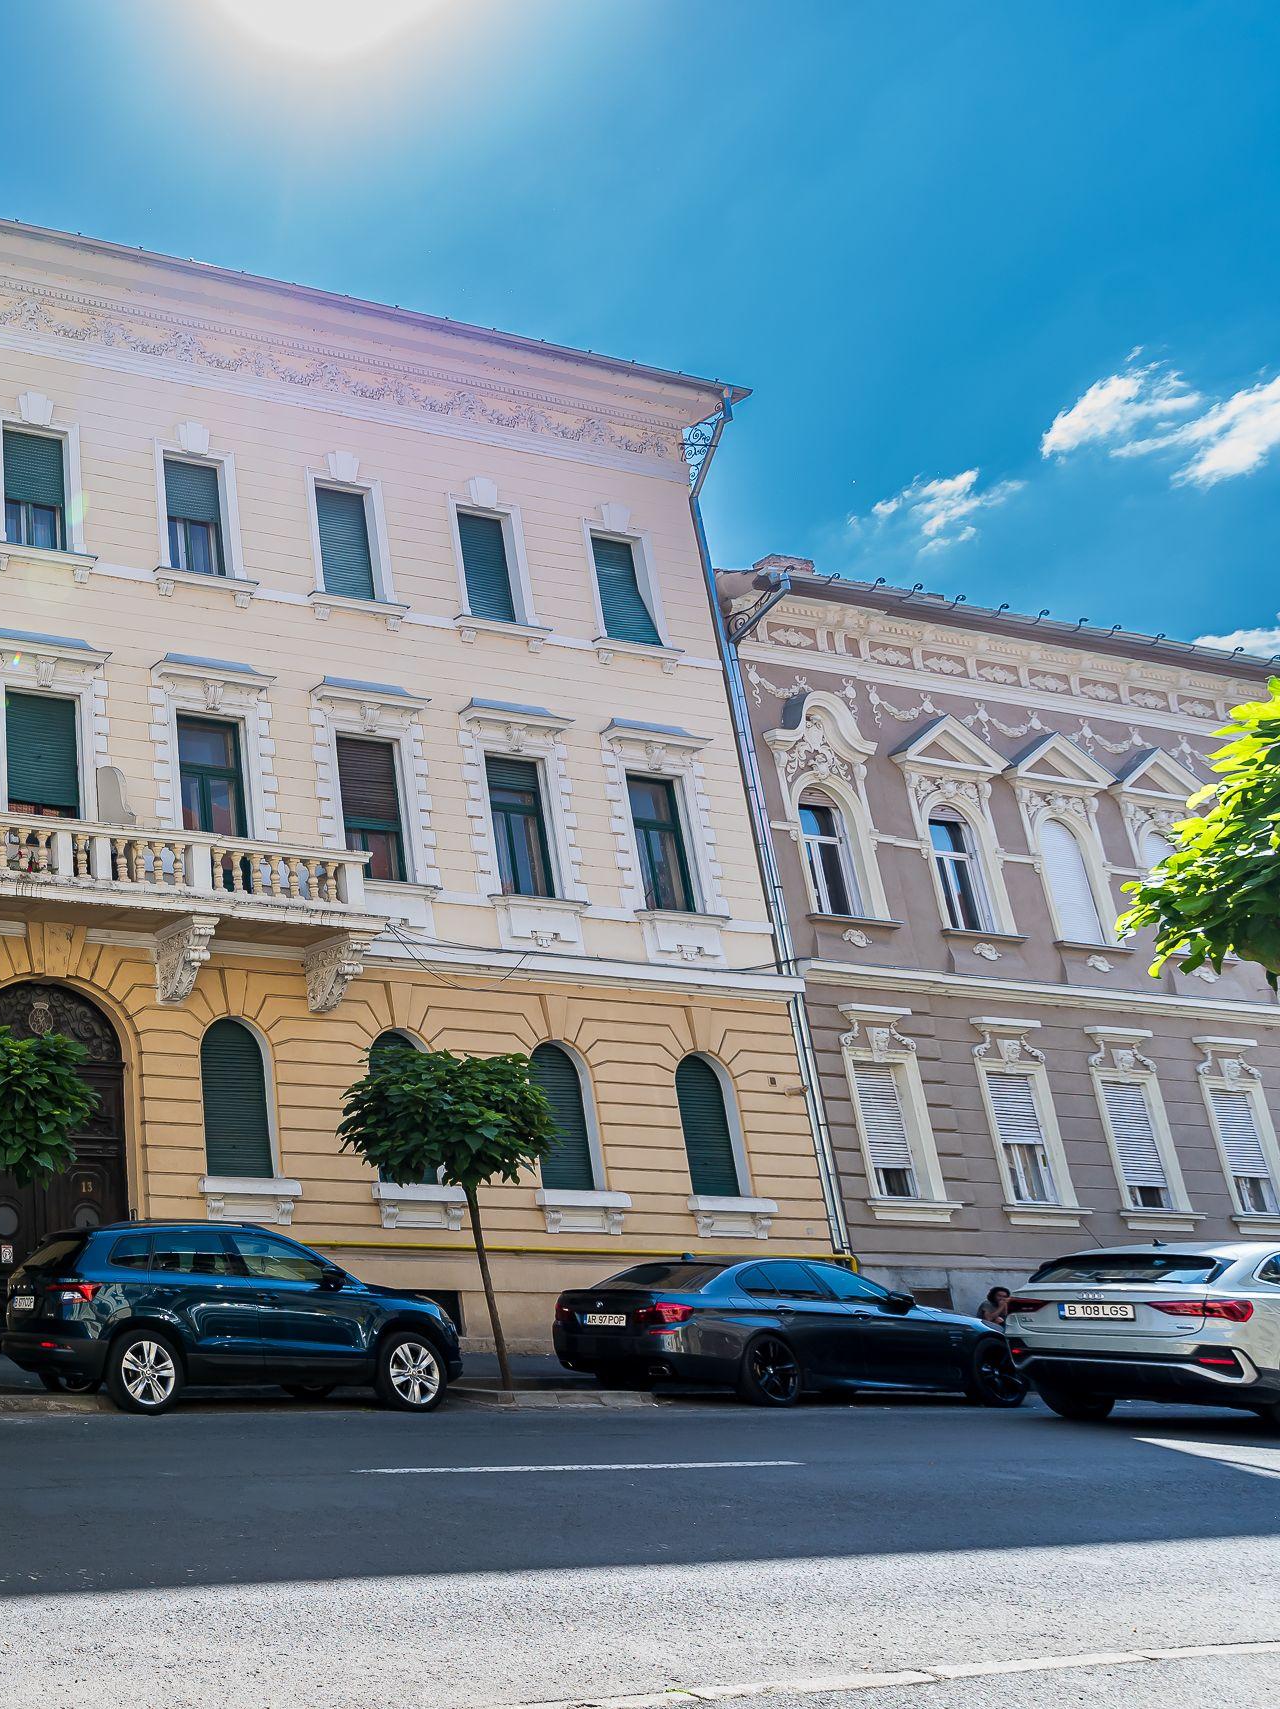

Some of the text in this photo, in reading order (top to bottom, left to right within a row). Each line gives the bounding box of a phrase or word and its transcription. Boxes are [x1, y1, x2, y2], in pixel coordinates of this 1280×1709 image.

[81, 1181, 93, 1193] 13
[1067, 1305, 1129, 1317] B 108 LGS
[587, 1315, 597, 1324] AR
[598, 1315, 608, 1324] 97
